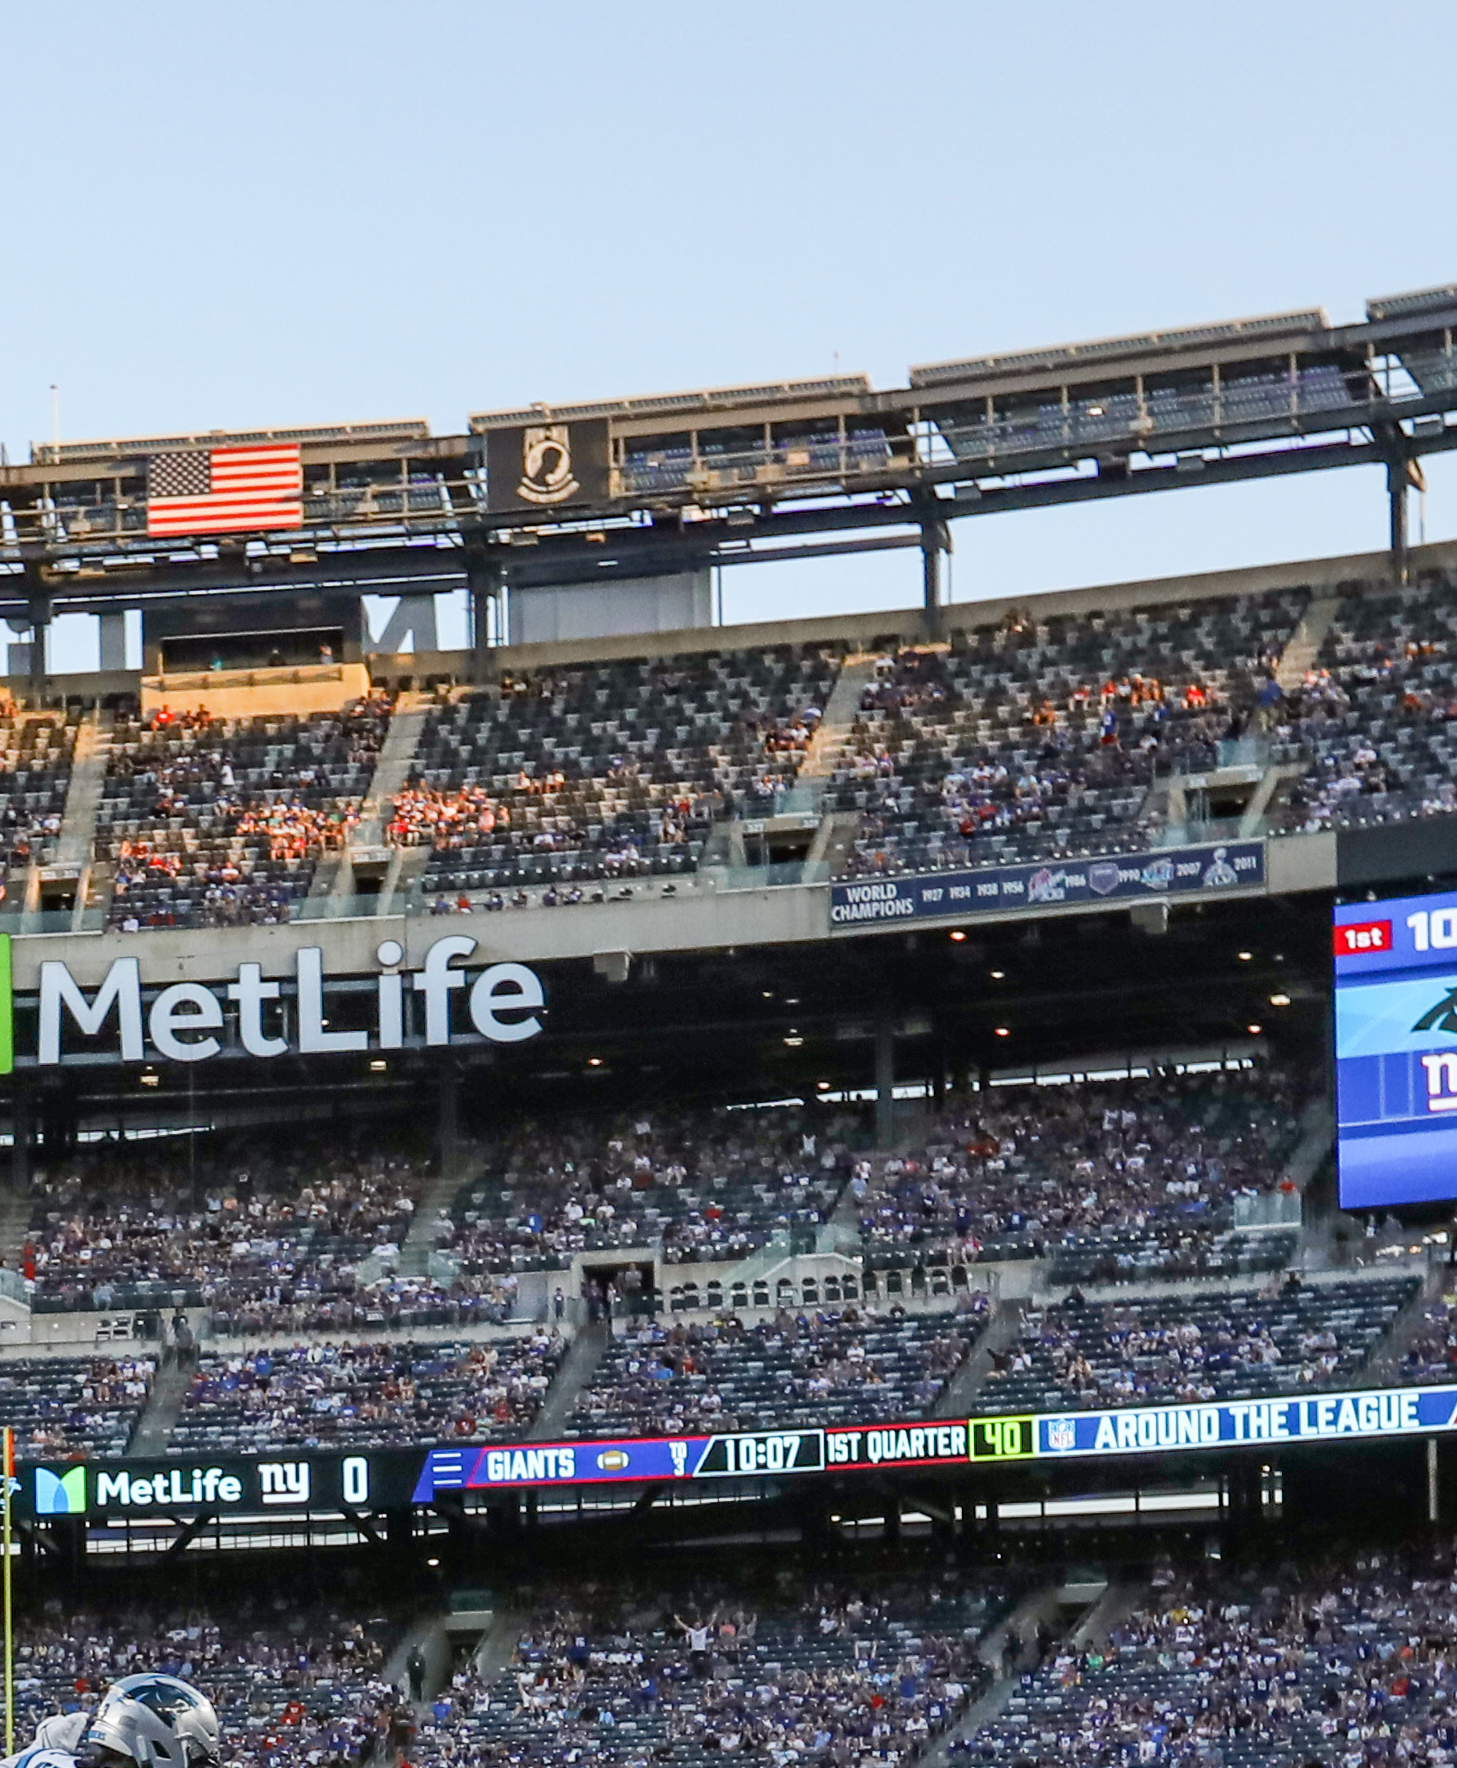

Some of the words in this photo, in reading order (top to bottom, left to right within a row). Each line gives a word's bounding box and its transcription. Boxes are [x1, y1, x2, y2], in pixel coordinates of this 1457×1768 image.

[832, 899, 913, 923] CHAMPIONS
[846, 884, 897, 903] WORLD
[1344, 927, 1383, 950] 1st
[37, 934, 546, 1066] MetLife
[983, 1420, 1021, 1456] 40
[1094, 1408, 1220, 1449] AROUND
[1228, 1402, 1290, 1440] THE
[1299, 1393, 1421, 1435] LEAGUE
[669, 1442, 687, 1459] TO
[725, 1435, 800, 1472] 10:07
[827, 1430, 862, 1463] 1ST
[866, 1425, 966, 1462] QUARTER
[341, 1456, 369, 1505] 0
[487, 1447, 576, 1482] GIANTS
[673, 1459, 686, 1476] 3
[97, 1467, 242, 1506] MetLife
